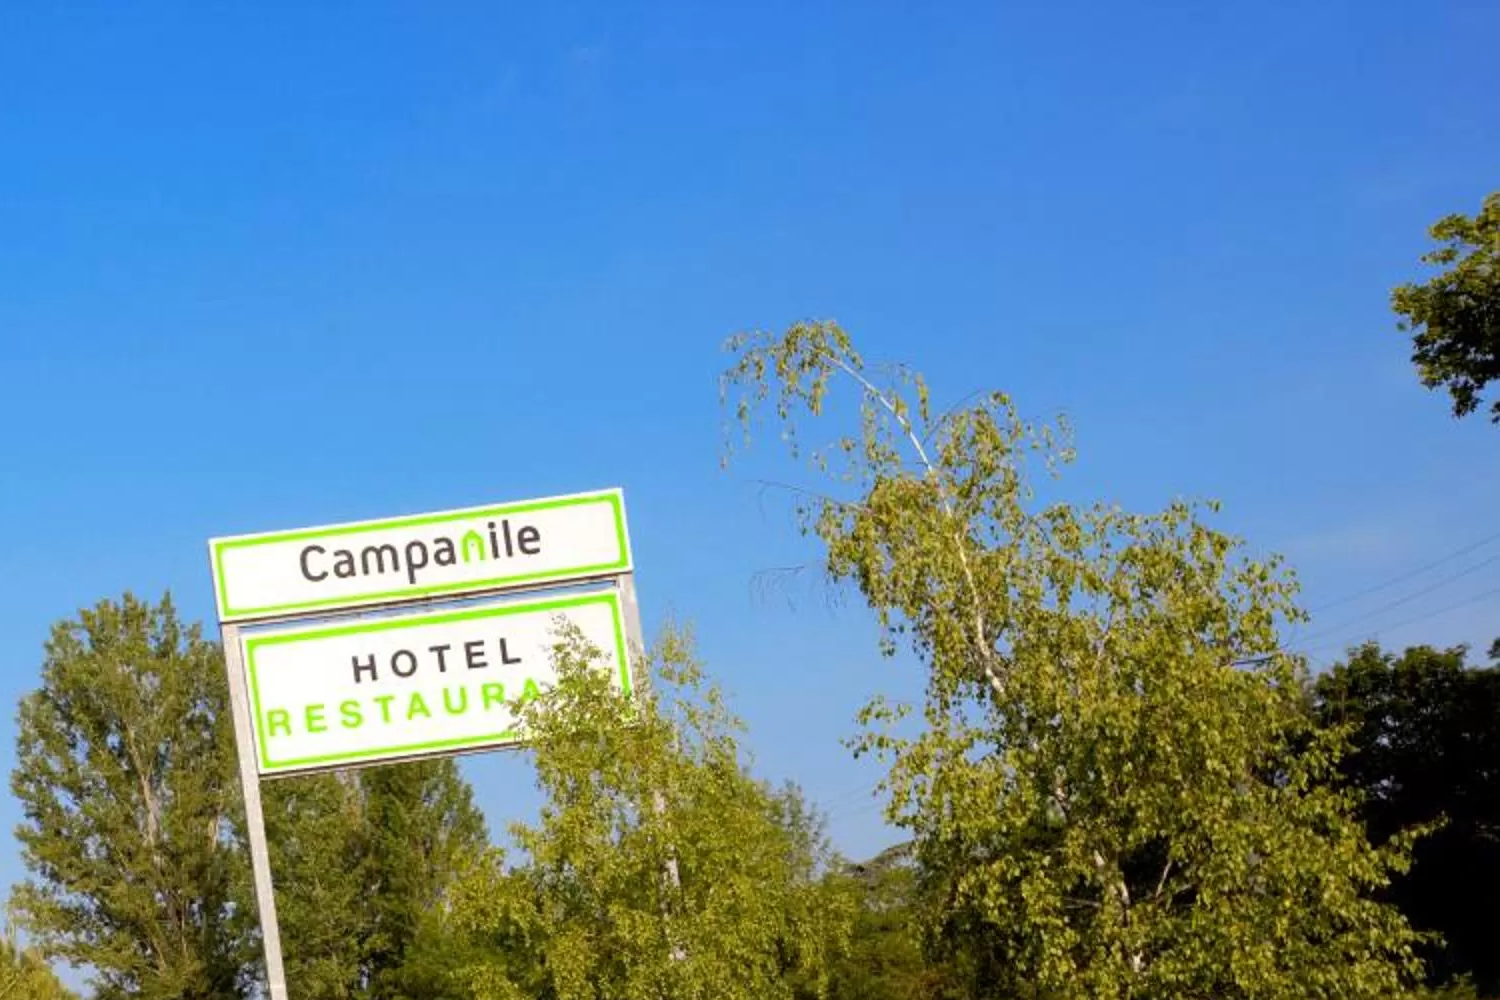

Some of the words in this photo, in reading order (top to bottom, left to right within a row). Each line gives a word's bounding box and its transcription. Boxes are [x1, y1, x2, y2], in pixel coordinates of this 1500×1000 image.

[300, 519, 541, 584] Campanile
[352, 637, 522, 683] HOTEL
[267, 678, 543, 737] RESTAURA
